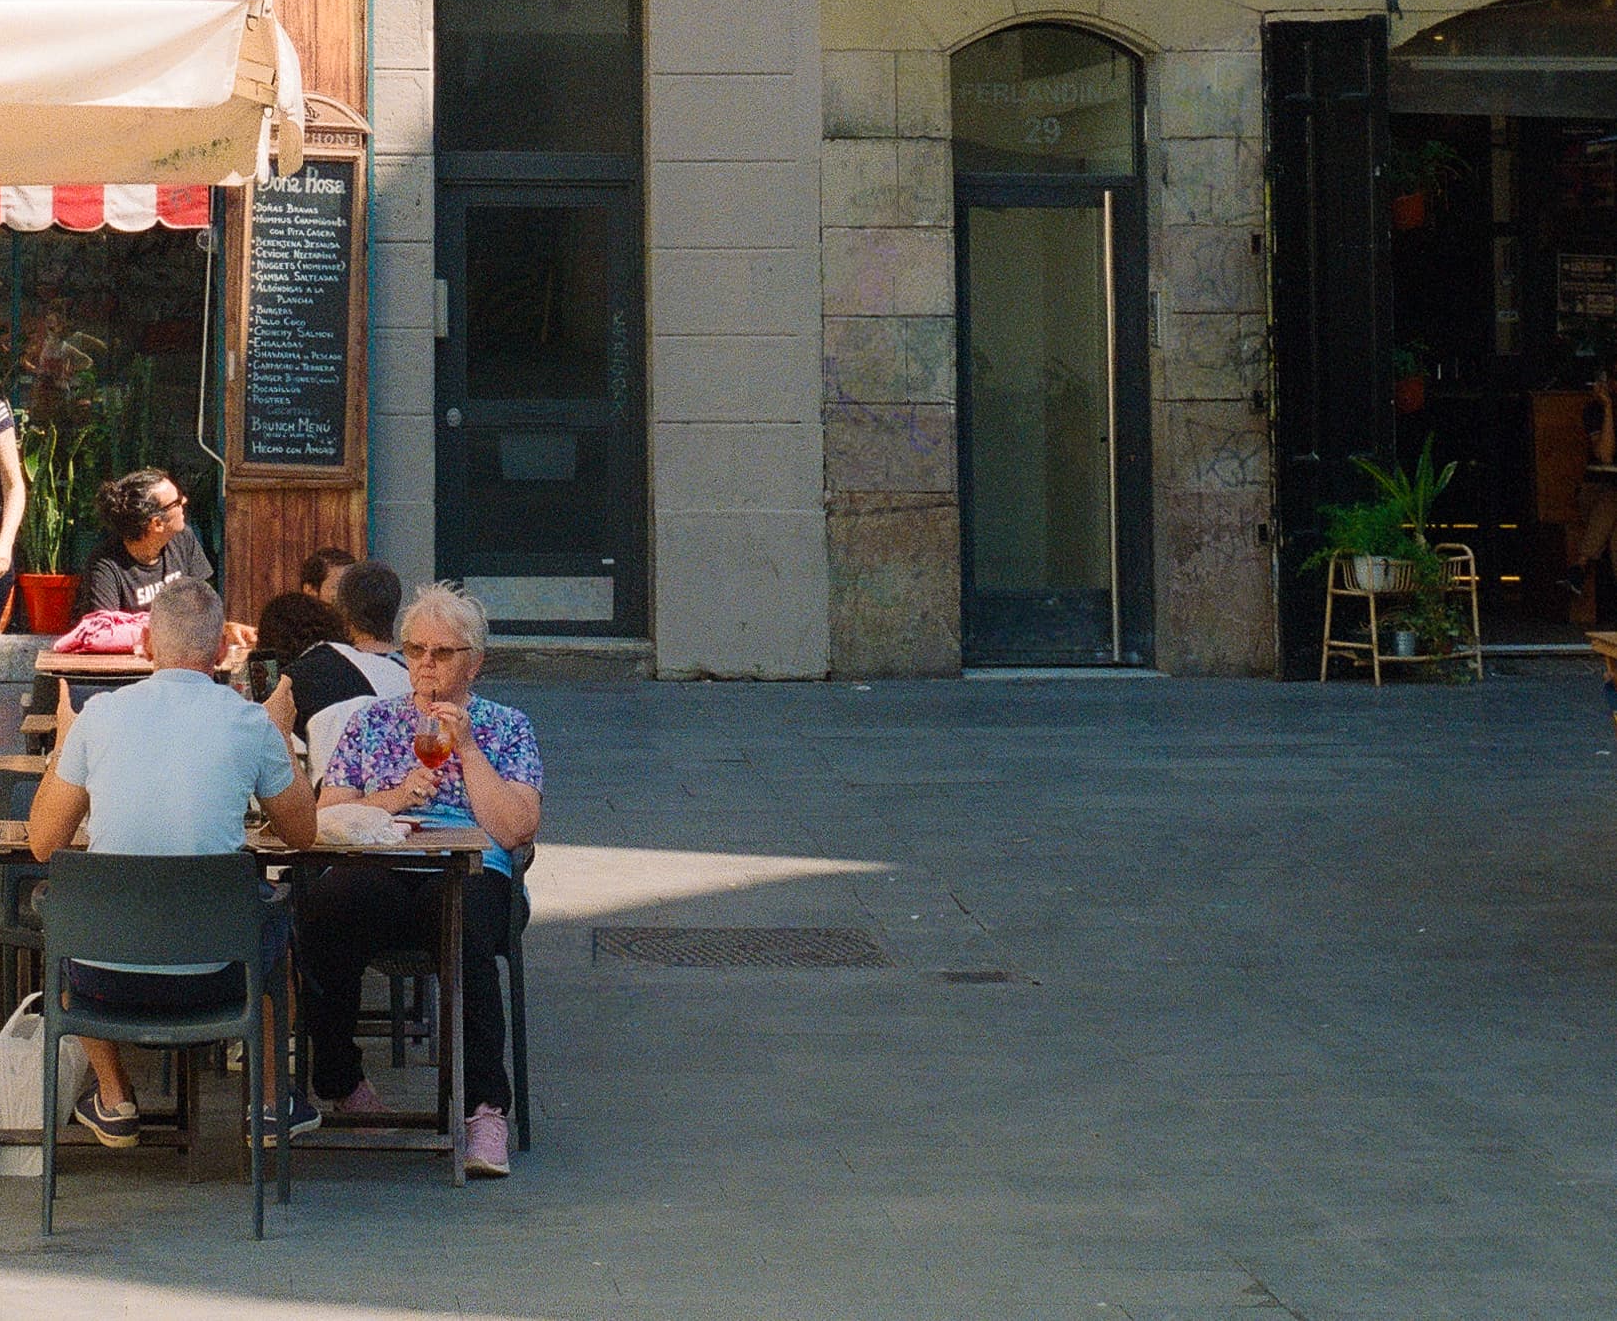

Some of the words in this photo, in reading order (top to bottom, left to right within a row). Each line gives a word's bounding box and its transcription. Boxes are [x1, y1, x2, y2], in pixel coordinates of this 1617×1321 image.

[1023, 116, 1063, 146] 29
[305, 164, 346, 194] Rosa
[251, 416, 296, 431] BRUNCH
